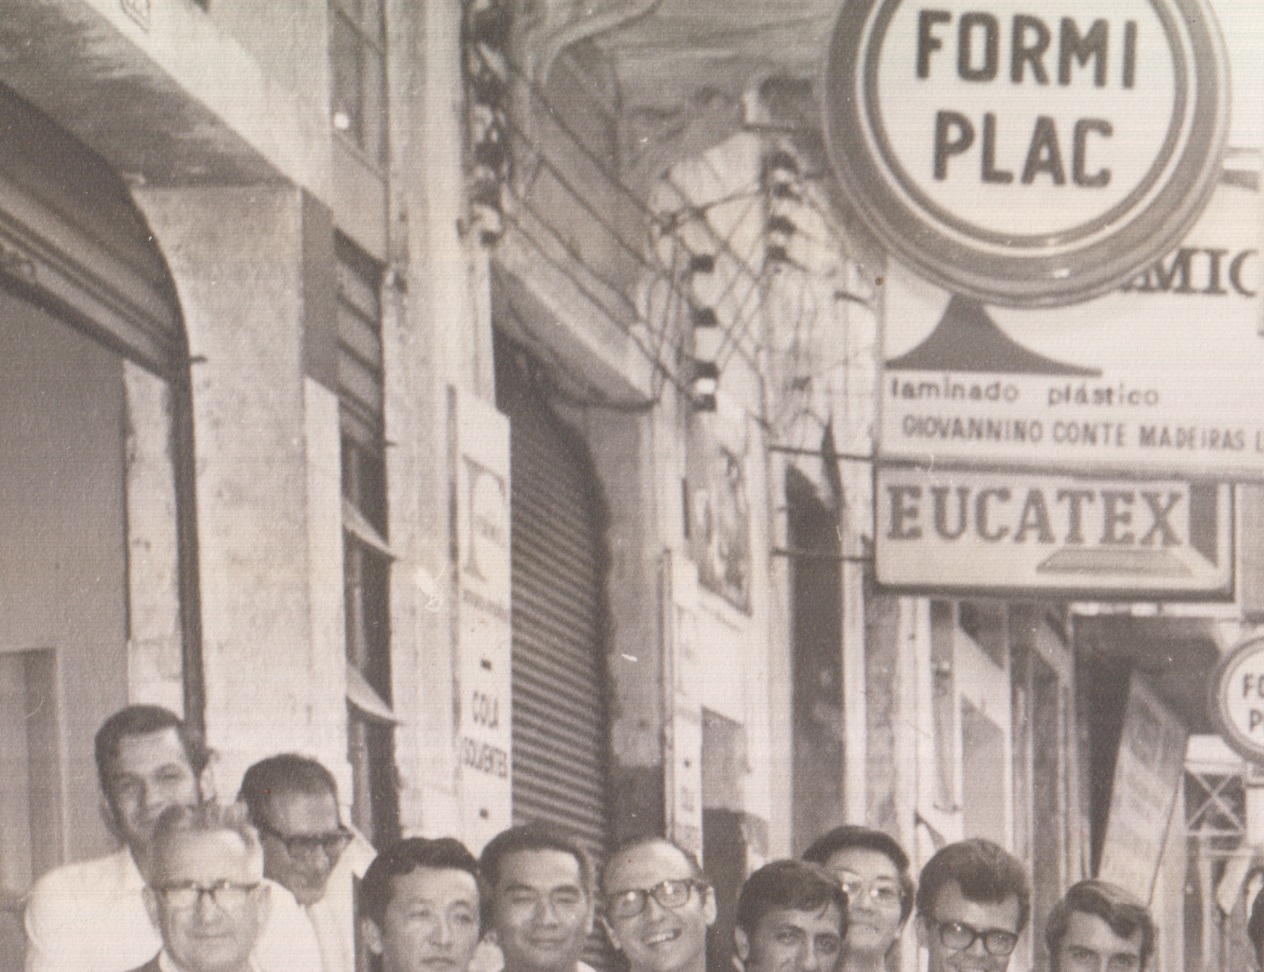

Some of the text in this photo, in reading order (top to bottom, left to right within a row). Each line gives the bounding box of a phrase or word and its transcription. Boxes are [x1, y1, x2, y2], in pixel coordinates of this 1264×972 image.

[914, 9, 1138, 90] FORMI
[932, 110, 1114, 188] PLAC
[1121, 247, 1259, 297] MIC
[889, 377, 1020, 402] laminado
[902, 414, 1044, 443] GIOVANNINO
[1052, 420, 1127, 448] CONTE
[1139, 425, 1246, 452] MADEIRAS
[885, 484, 1184, 547] EUCATEX
